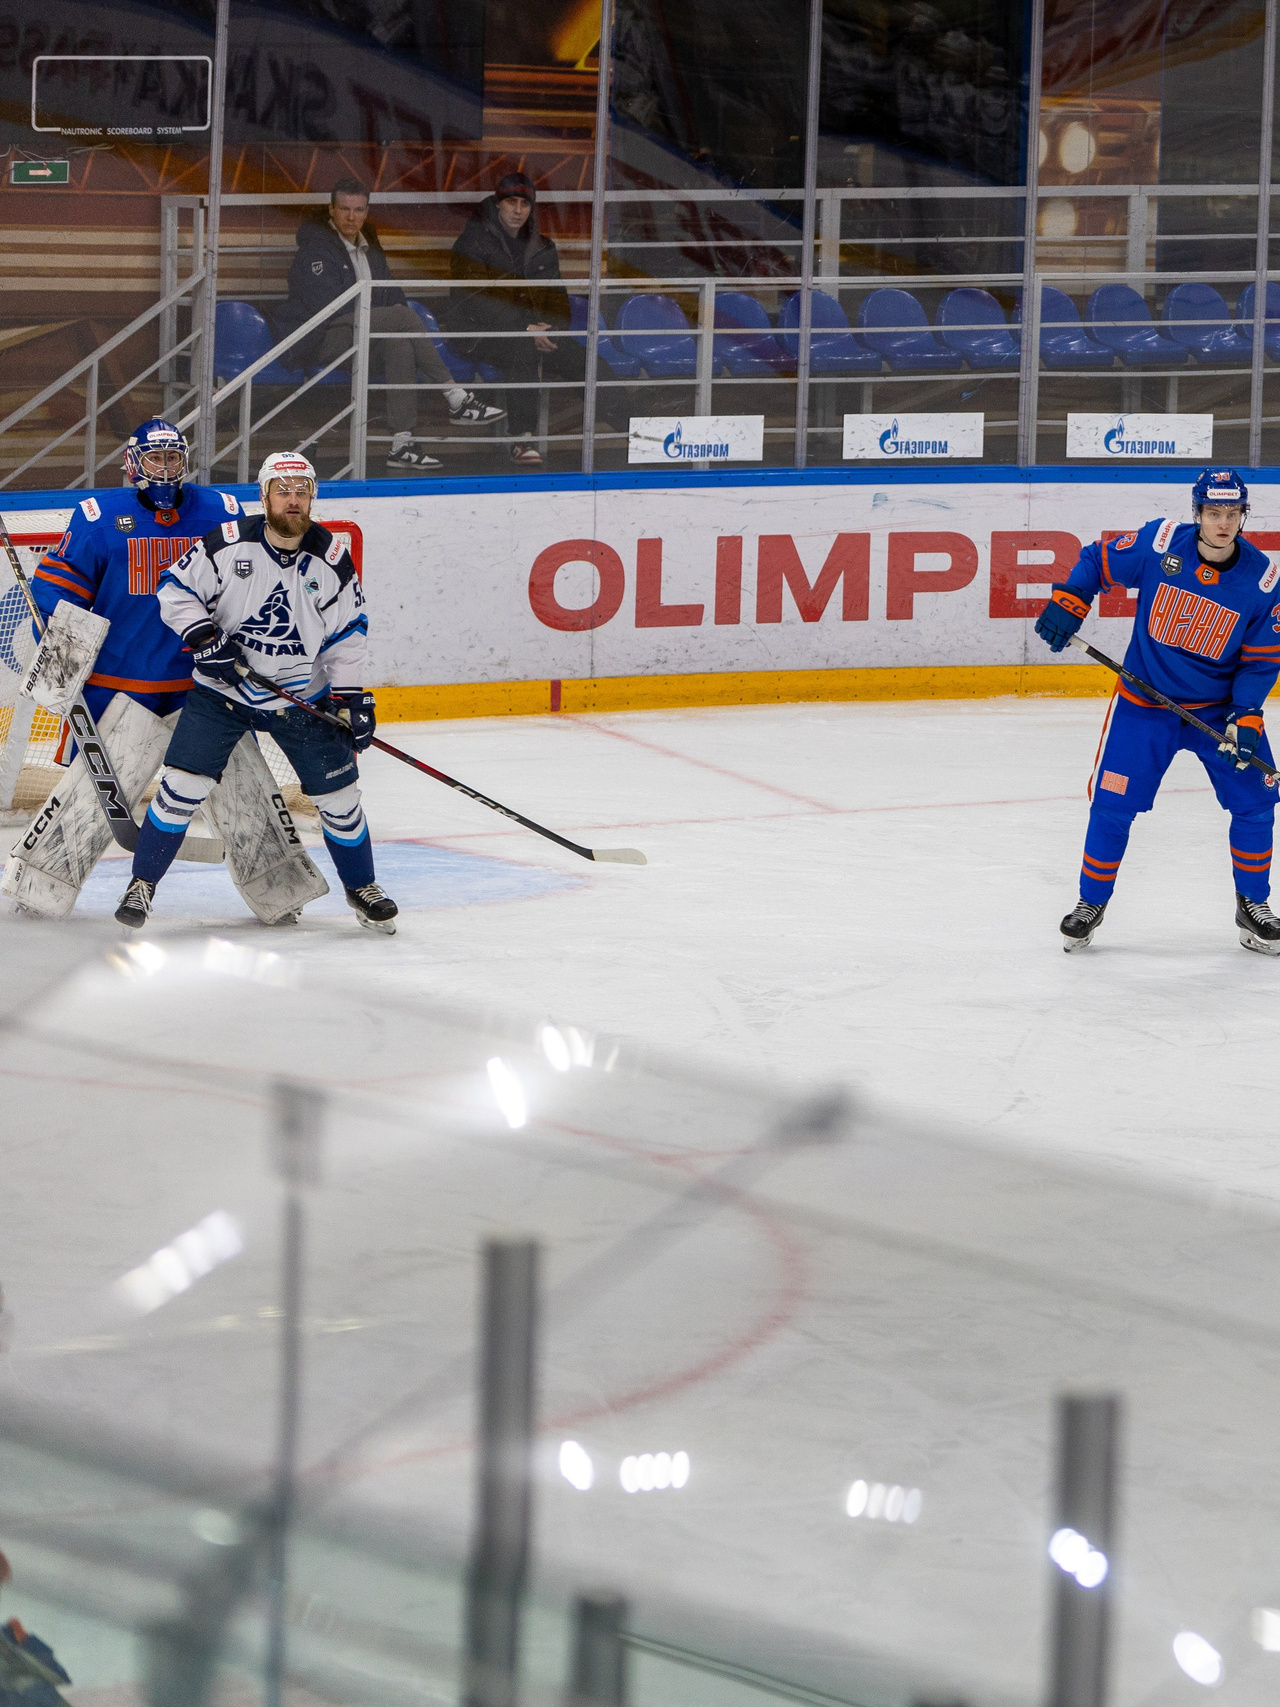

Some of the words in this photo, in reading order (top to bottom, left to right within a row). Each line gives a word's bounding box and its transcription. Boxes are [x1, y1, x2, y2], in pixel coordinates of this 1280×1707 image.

[60, 127, 103, 136] NAUTRONIC
[106, 127, 153, 135] SCOREBOARD
[156, 126, 182, 135] SYSTEM
[275, 462, 306, 470] OLIMPBET
[1208, 490, 1239, 498] OLIMPBET
[69, 704, 131, 820] CCM
[23, 795, 61, 851] CCM
[271, 793, 301, 845] CCM
